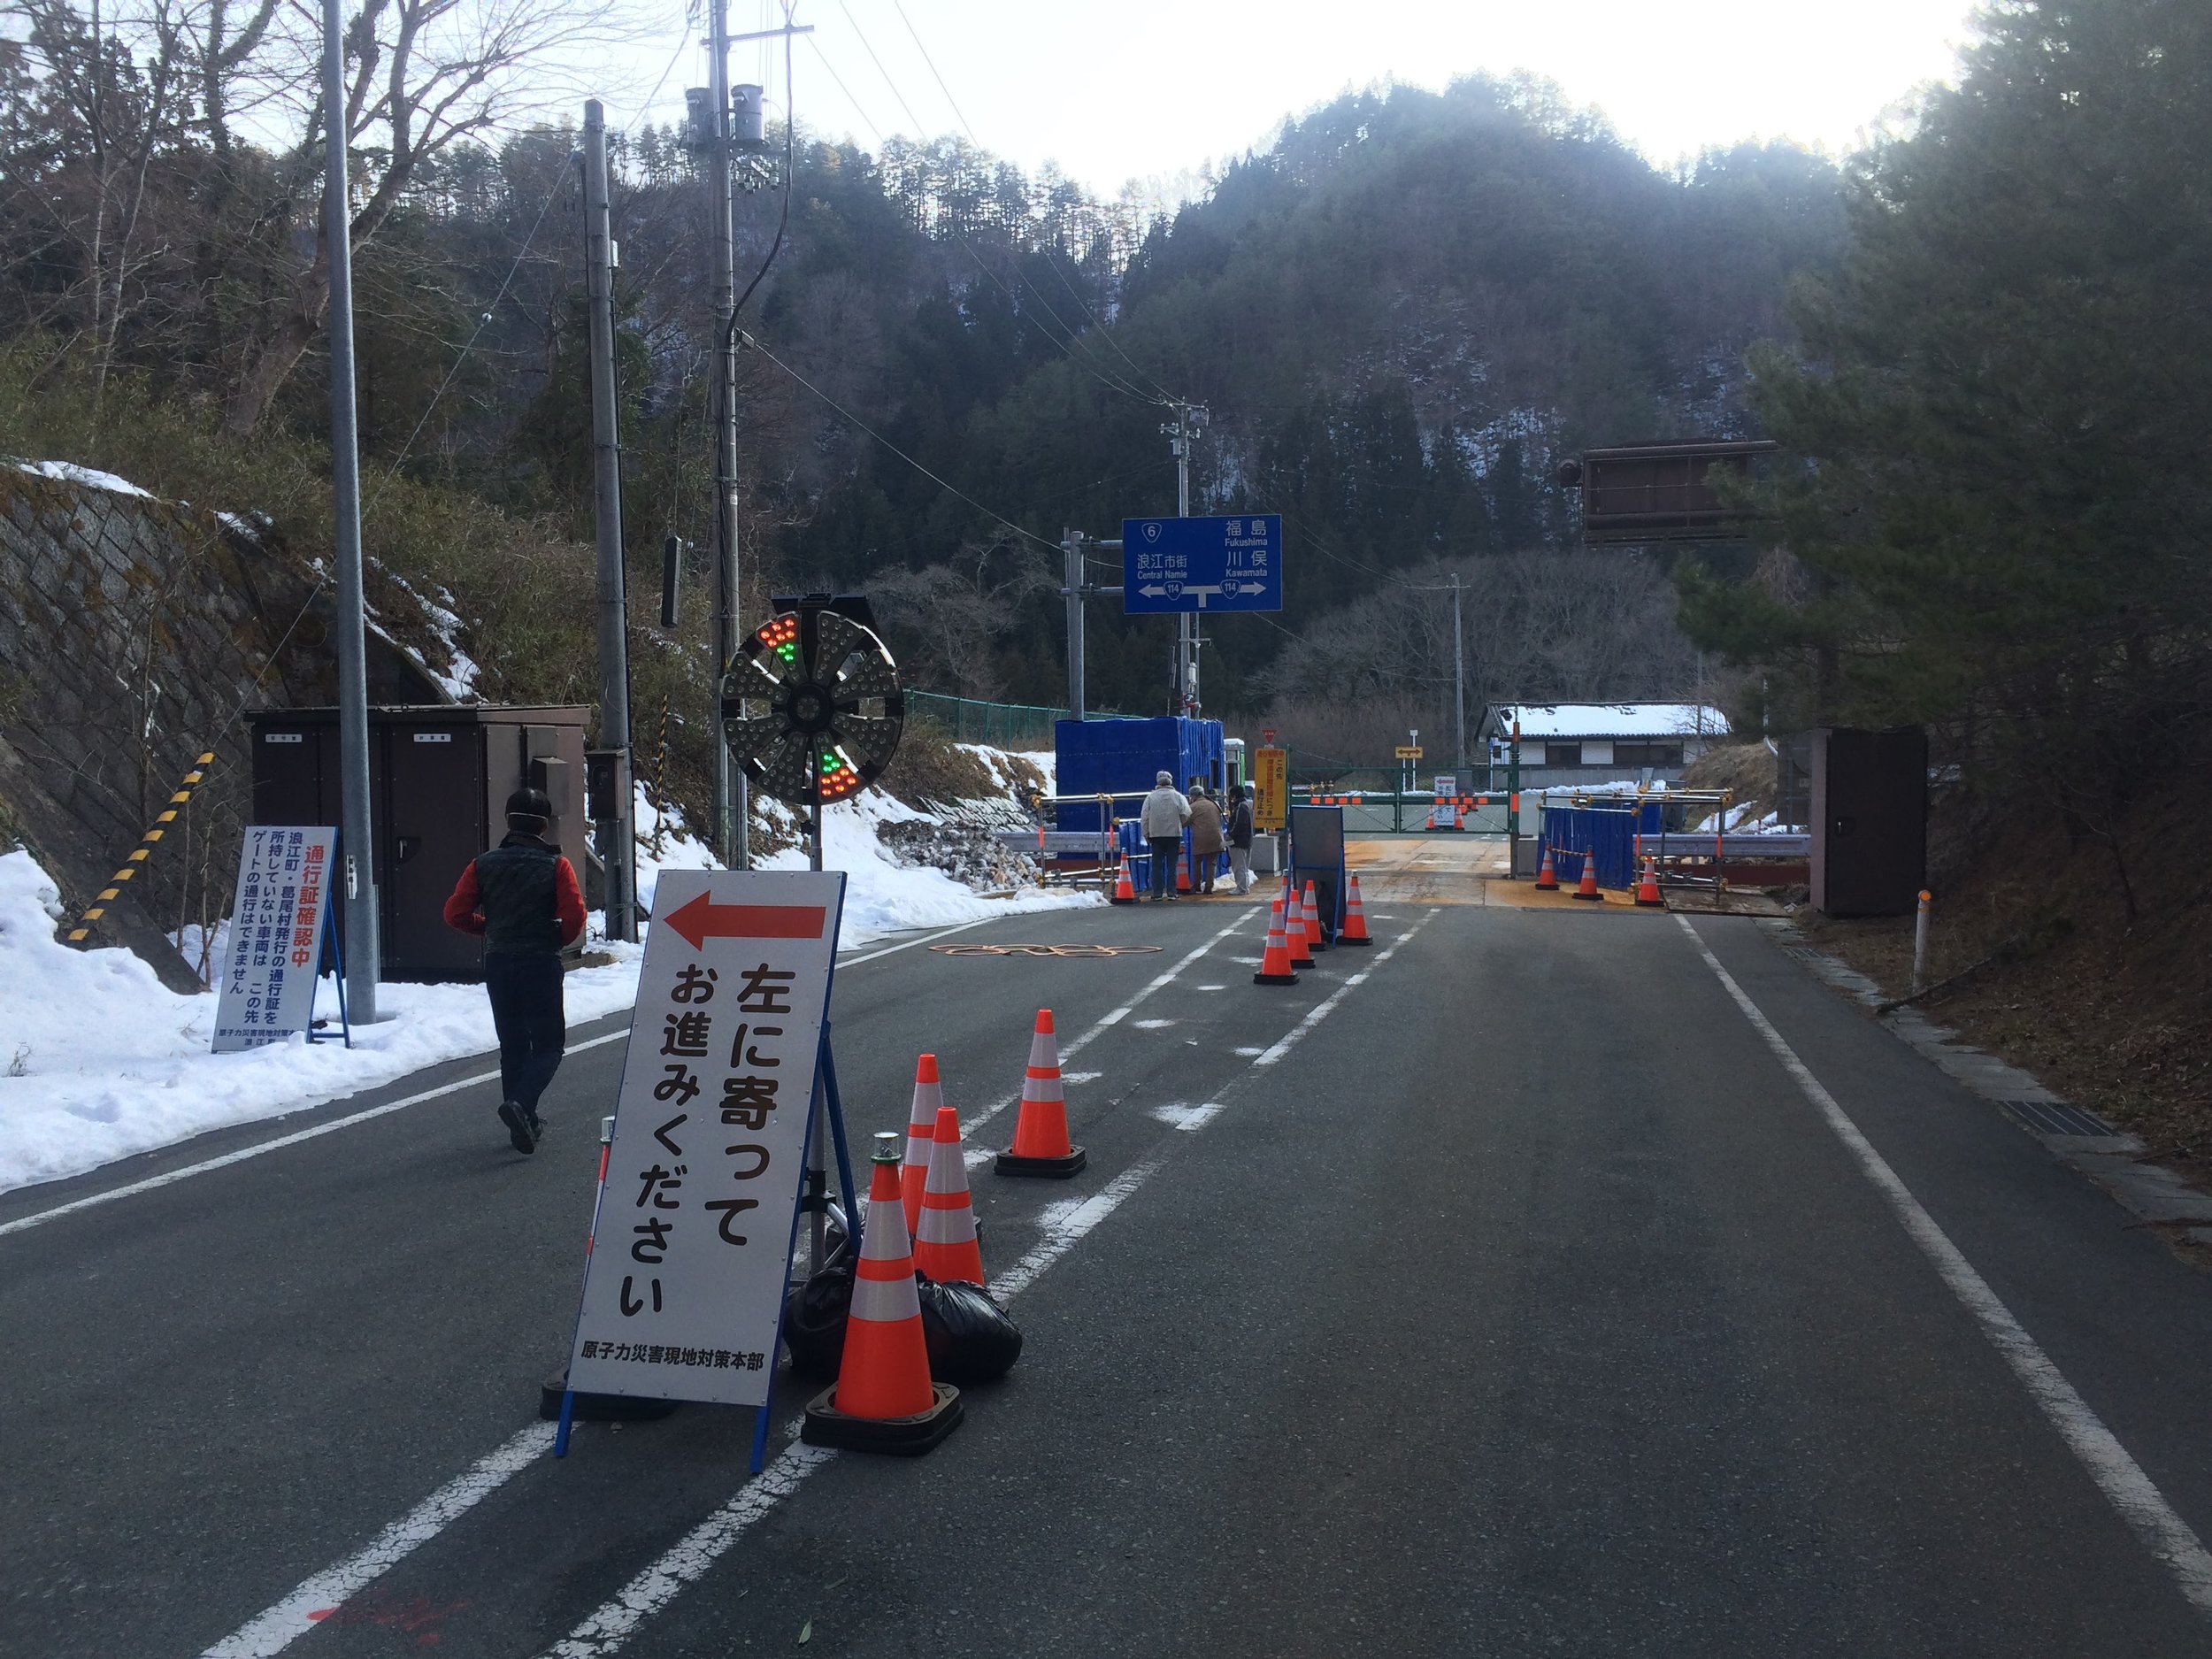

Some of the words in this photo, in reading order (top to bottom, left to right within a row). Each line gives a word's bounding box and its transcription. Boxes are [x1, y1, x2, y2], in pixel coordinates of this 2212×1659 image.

[1148, 526, 1156, 538] 6
[1225, 518, 1267, 537] 福島
[1225, 537, 1268, 547] Fukushima
[1137, 553, 1187, 570] 浪江市街
[1226, 549, 1268, 567] 川俣
[1137, 570, 1163, 580] Central
[1164, 570, 1187, 580] Namie
[1225, 568, 1268, 578] Kawamata
[1167, 583, 1179, 595] 114
[1224, 582, 1237, 593] 114
[228, 830, 268, 995] ゲートの通行はできません
[291, 844, 325, 968] 通行証確認中
[264, 831, 303, 1025] 浪江町・葛尾村発行の通行証を
[704, 963, 796, 1247] 左に寄って
[619, 963, 715, 1317] お進みください
[580, 1340, 765, 1371] 原子力災害現地対策本部
